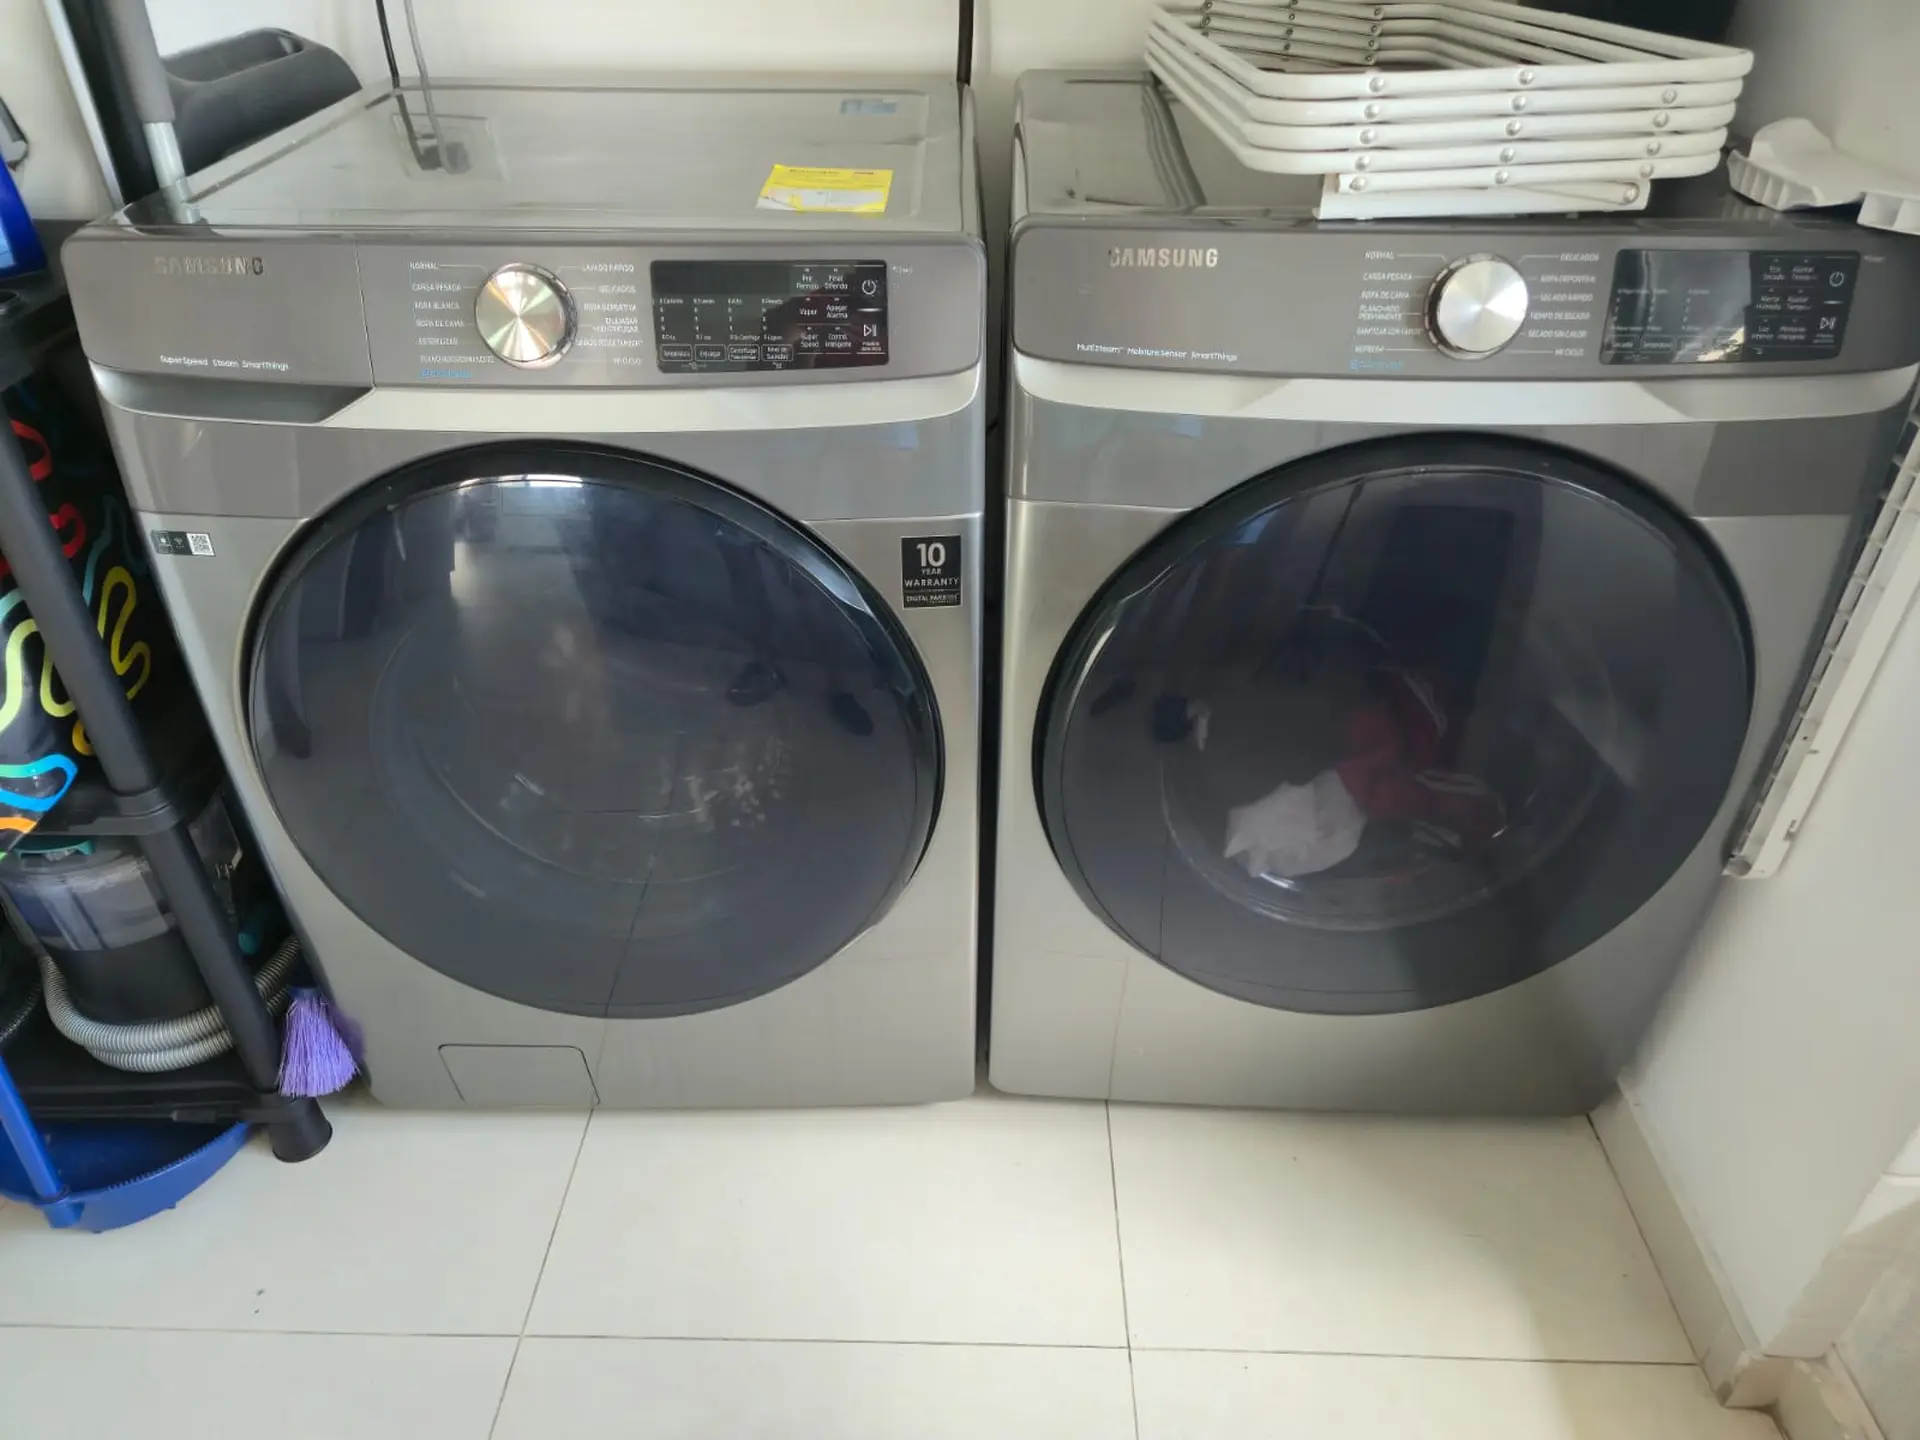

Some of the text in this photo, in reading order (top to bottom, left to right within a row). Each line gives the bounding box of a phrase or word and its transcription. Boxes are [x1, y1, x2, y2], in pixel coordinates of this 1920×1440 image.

[154, 256, 264, 276] SAMSUNG
[1109, 247, 1220, 269] SAMSUNG
[160, 354, 208, 368] SuperSpeed
[242, 358, 290, 372] SmartThings
[916, 542, 946, 567] 10
[904, 577, 959, 588] WARRANTY
